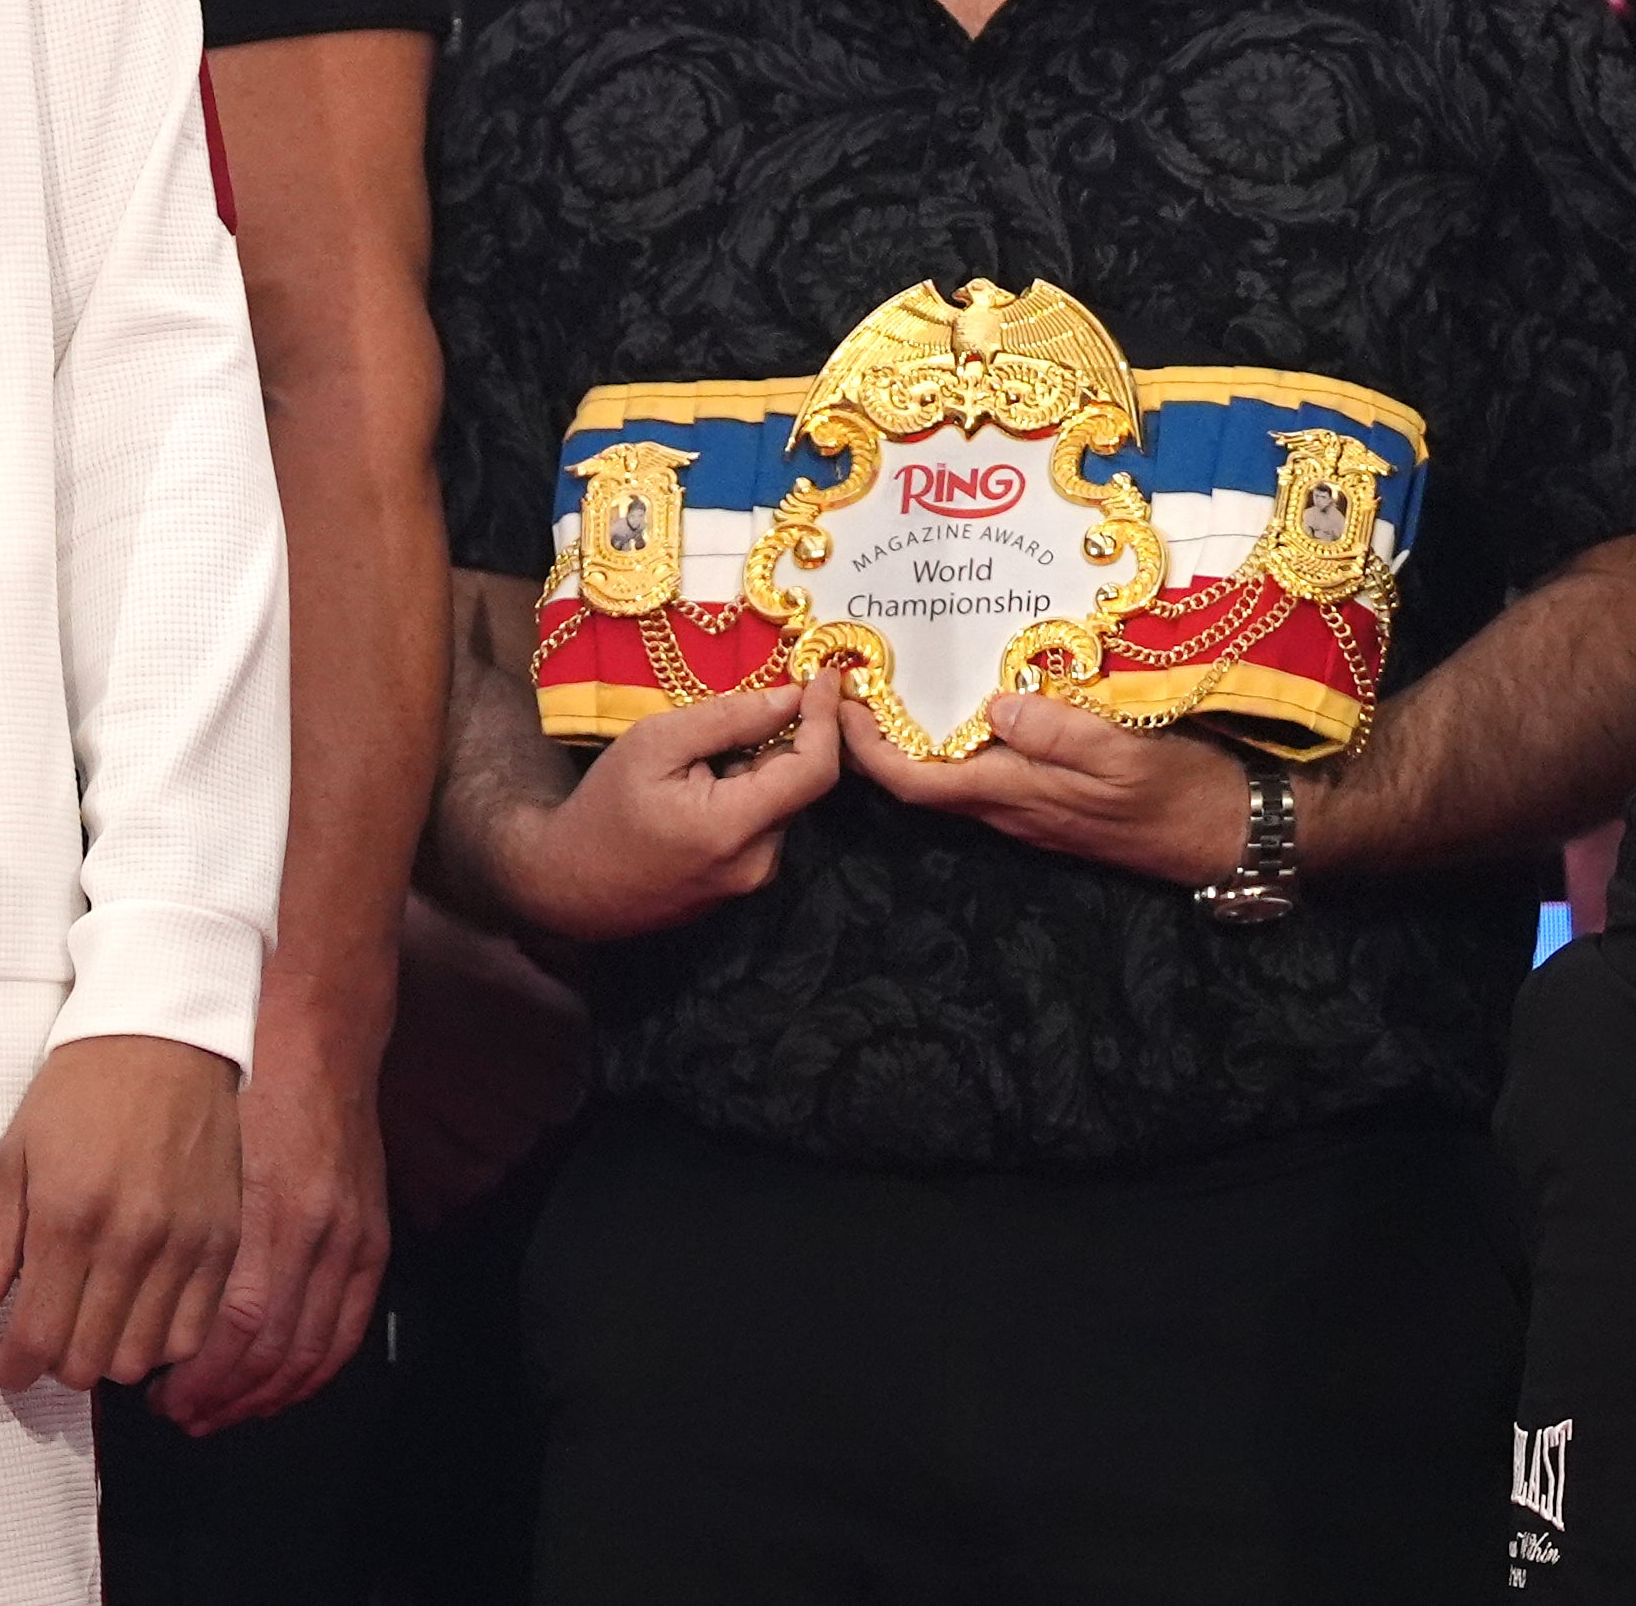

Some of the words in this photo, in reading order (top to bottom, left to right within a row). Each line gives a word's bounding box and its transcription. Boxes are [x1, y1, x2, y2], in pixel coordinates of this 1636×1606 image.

[852, 523, 973, 573] MAGAZINE
[979, 526, 1054, 566] AWARD
[913, 557, 993, 583] World
[847, 589, 1052, 622] Championship
